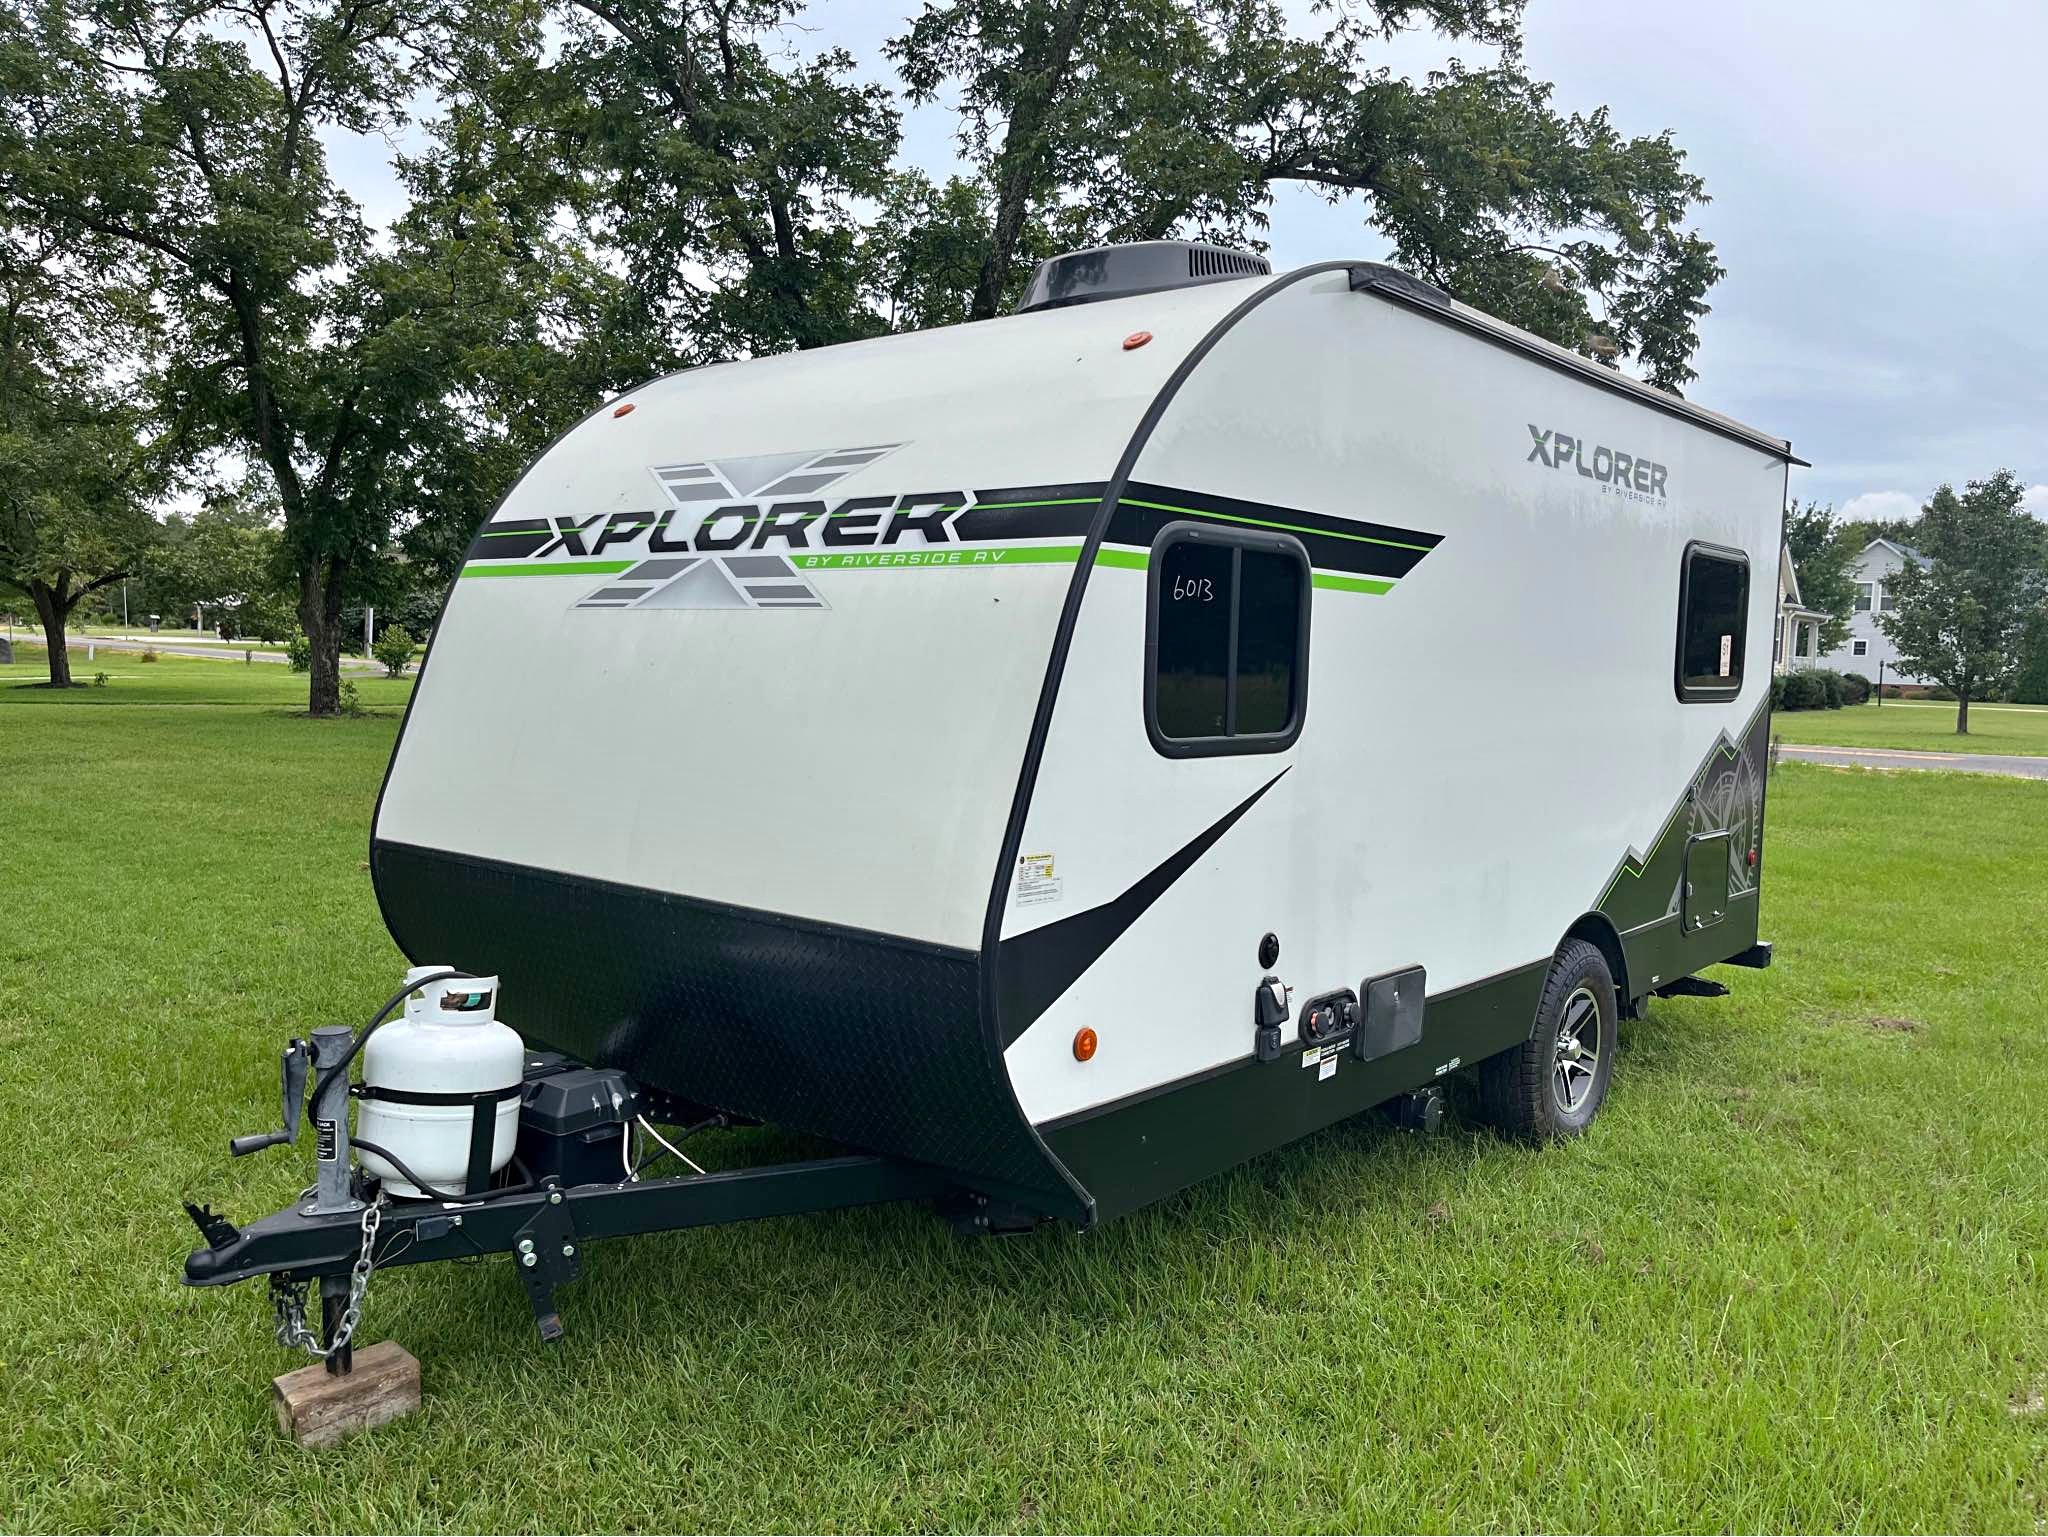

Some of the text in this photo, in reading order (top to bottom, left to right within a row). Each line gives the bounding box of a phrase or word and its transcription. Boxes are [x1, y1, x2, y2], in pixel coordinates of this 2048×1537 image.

[1527, 423, 1667, 497] XPLORER
[535, 491, 967, 557] XPLORER
[806, 551, 1006, 567] BY RIVERSIDE RV
[1174, 575, 1213, 601] 6013
